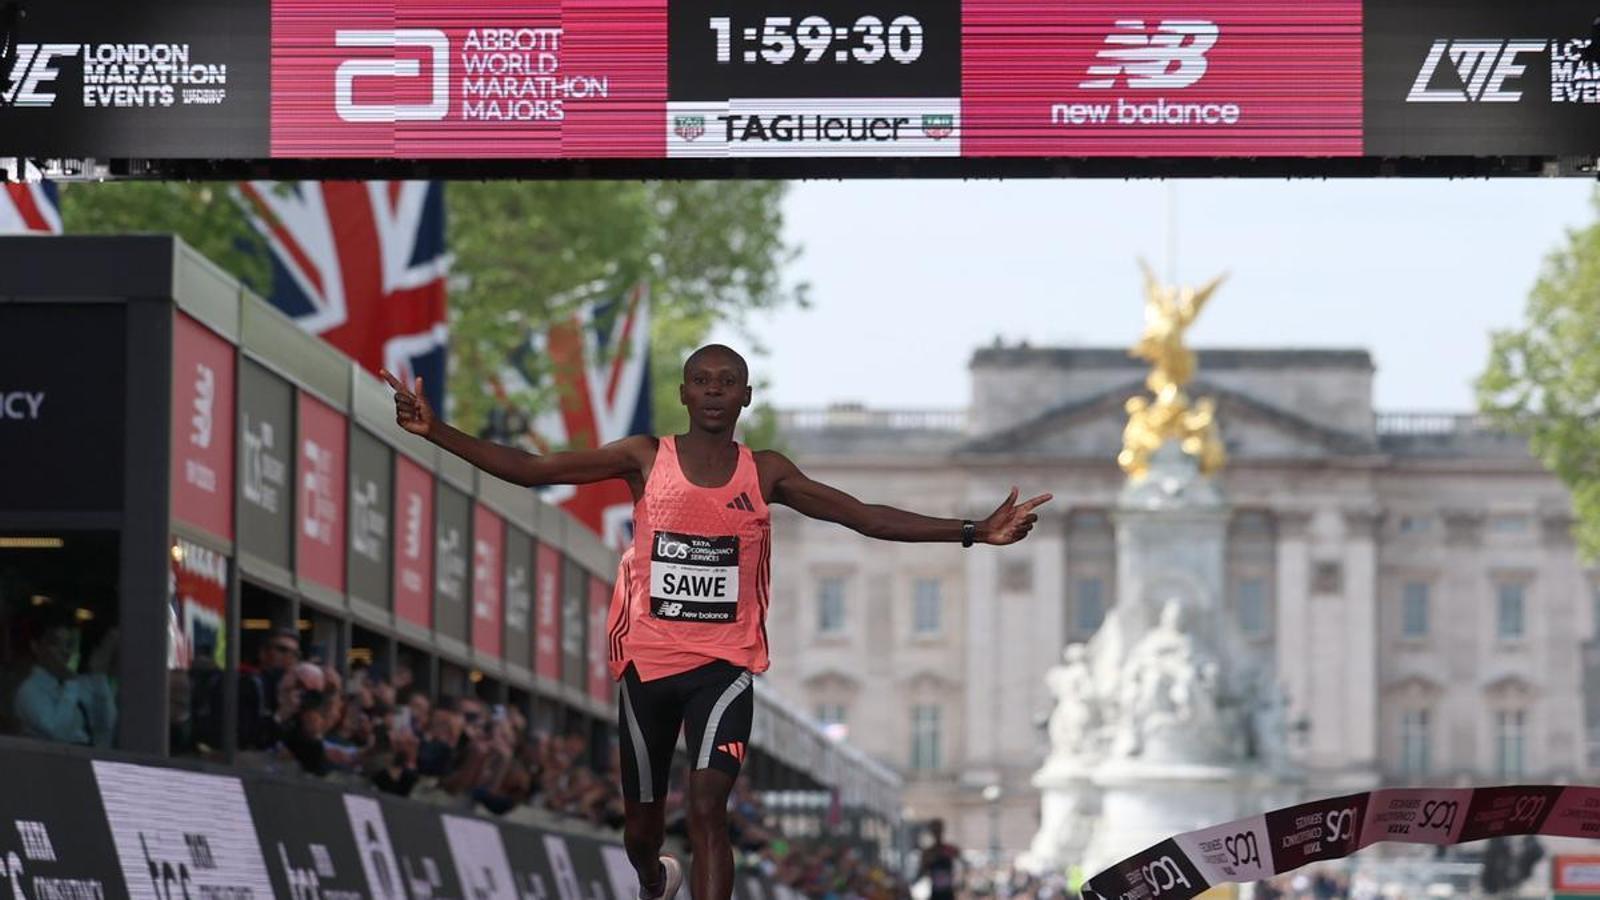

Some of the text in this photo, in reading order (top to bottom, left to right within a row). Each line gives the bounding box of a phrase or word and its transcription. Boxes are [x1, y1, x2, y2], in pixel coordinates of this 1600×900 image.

[462, 28, 563, 51] ABBOTT
[709, 15, 923, 64] 1:59:30
[83, 44, 189, 65] LONDON
[462, 53, 559, 76] WORLD
[83, 64, 226, 84] MARATHON
[83, 85, 174, 107] EVENTS
[462, 76, 608, 98] MARATHON
[462, 99, 565, 120] MAJORS
[1051, 97, 1241, 125] new balance
[657, 536, 691, 559] tcs
[663, 573, 727, 597] SAWE
[699, 611, 729, 620] balance
[1418, 800, 1459, 837] tcs
[1225, 830, 1262, 869] tcs
[1141, 855, 1192, 897] tcs
